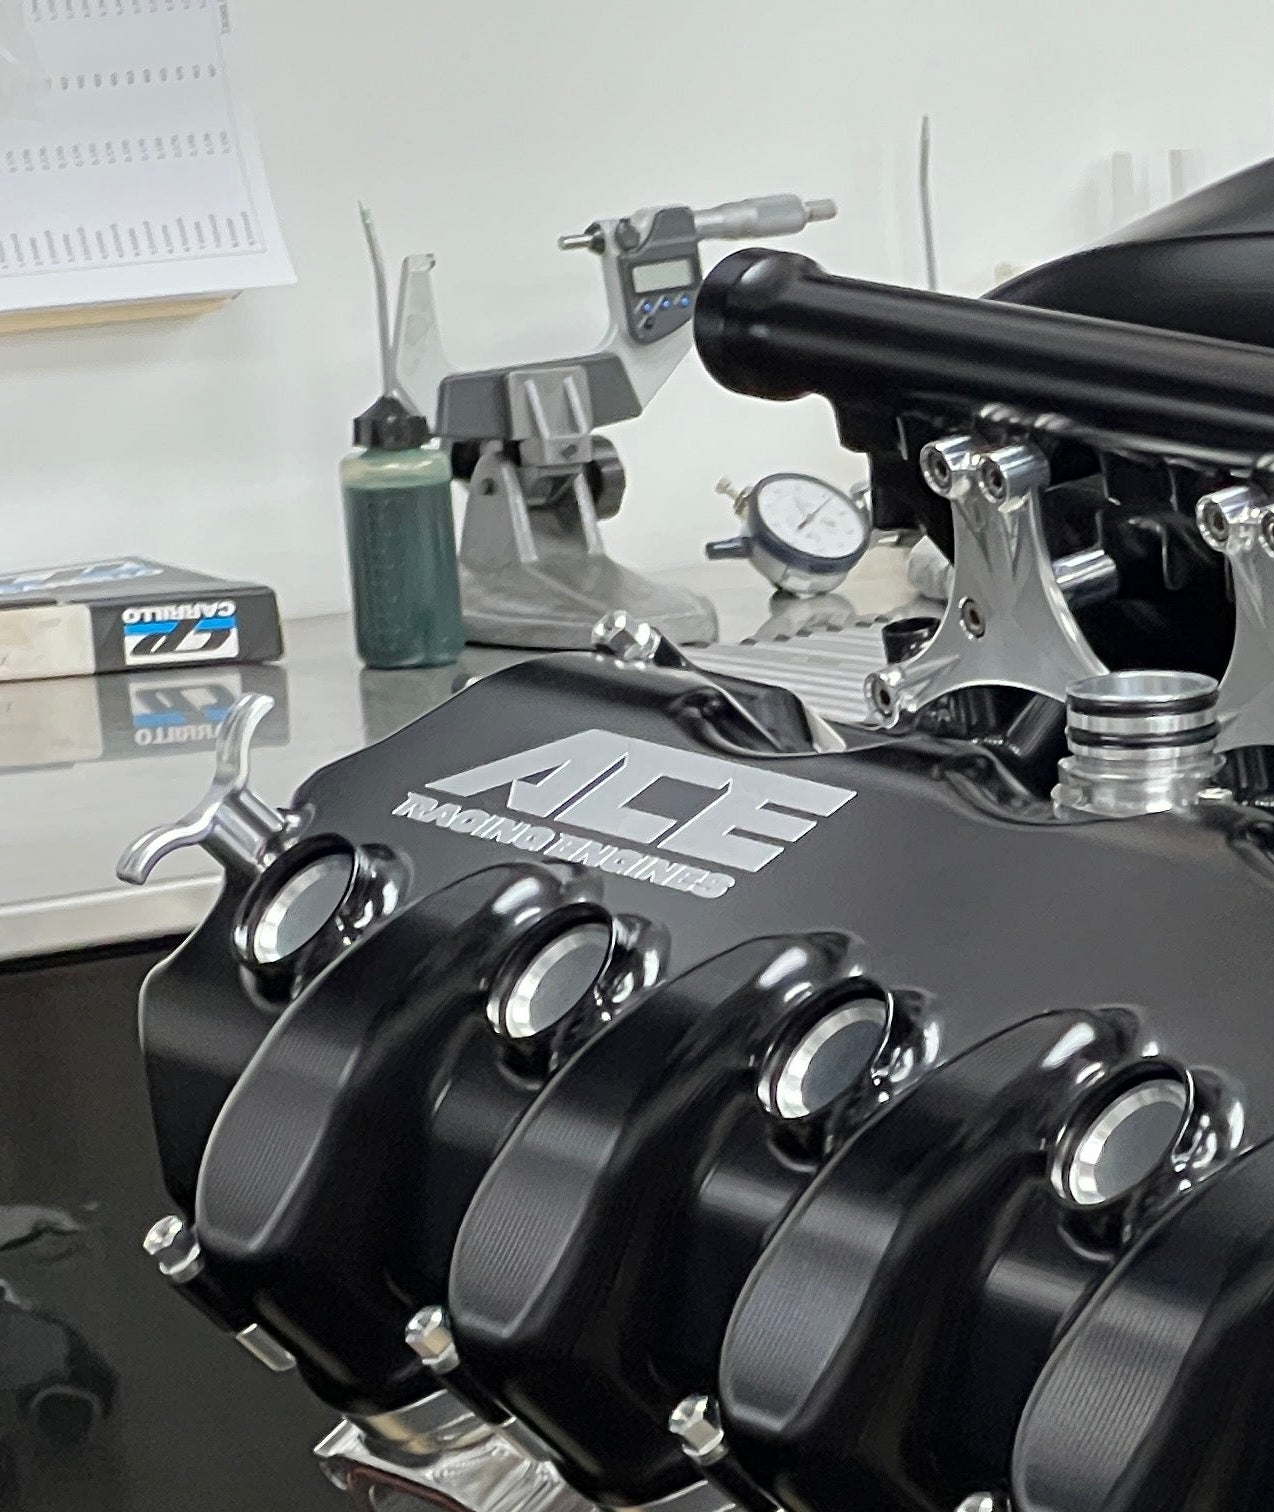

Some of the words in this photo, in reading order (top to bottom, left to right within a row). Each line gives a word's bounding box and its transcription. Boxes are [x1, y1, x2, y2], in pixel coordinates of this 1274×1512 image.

[121, 600, 237, 625] CARRILLO
[391, 791, 557, 853] RACING
[542, 831, 737, 900] ENGINES
[424, 728, 858, 873] ACE
